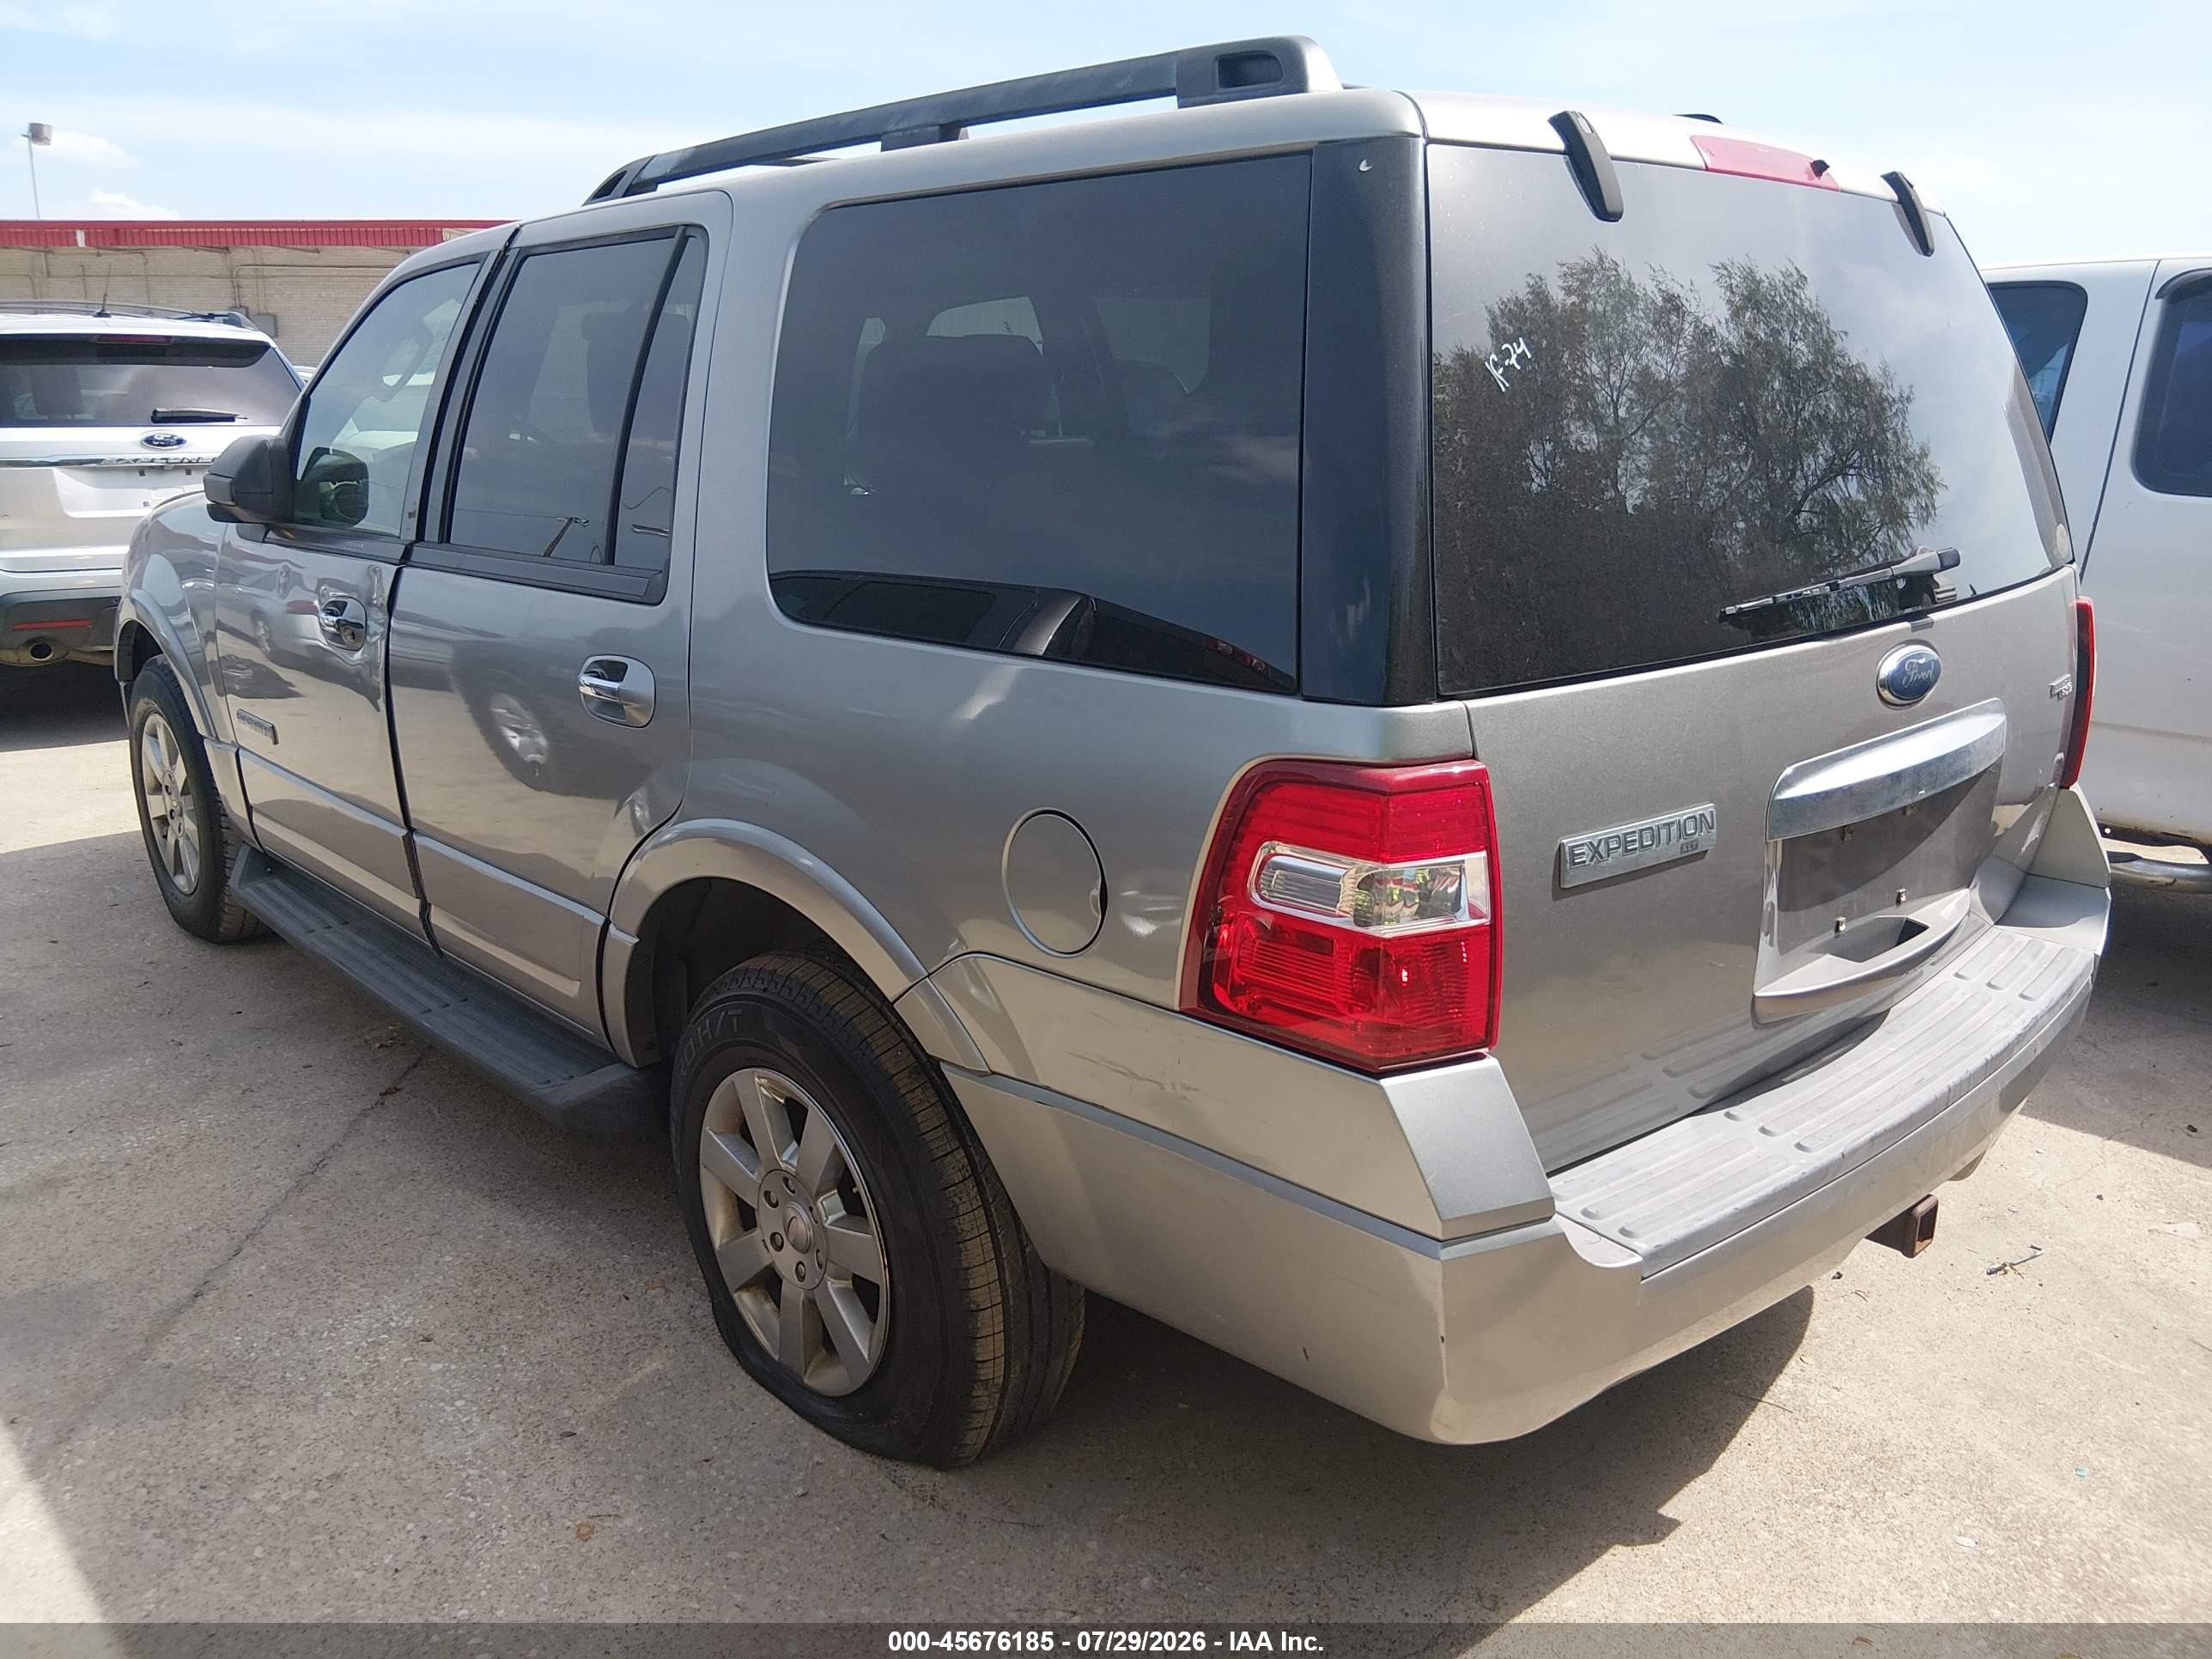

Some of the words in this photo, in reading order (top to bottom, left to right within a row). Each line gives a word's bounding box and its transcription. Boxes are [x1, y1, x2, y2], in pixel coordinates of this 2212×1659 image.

[1901, 657, 1935, 689] Ford
[1567, 809, 1716, 871] EXPEDITION
[1680, 840, 1699, 854] XLT
